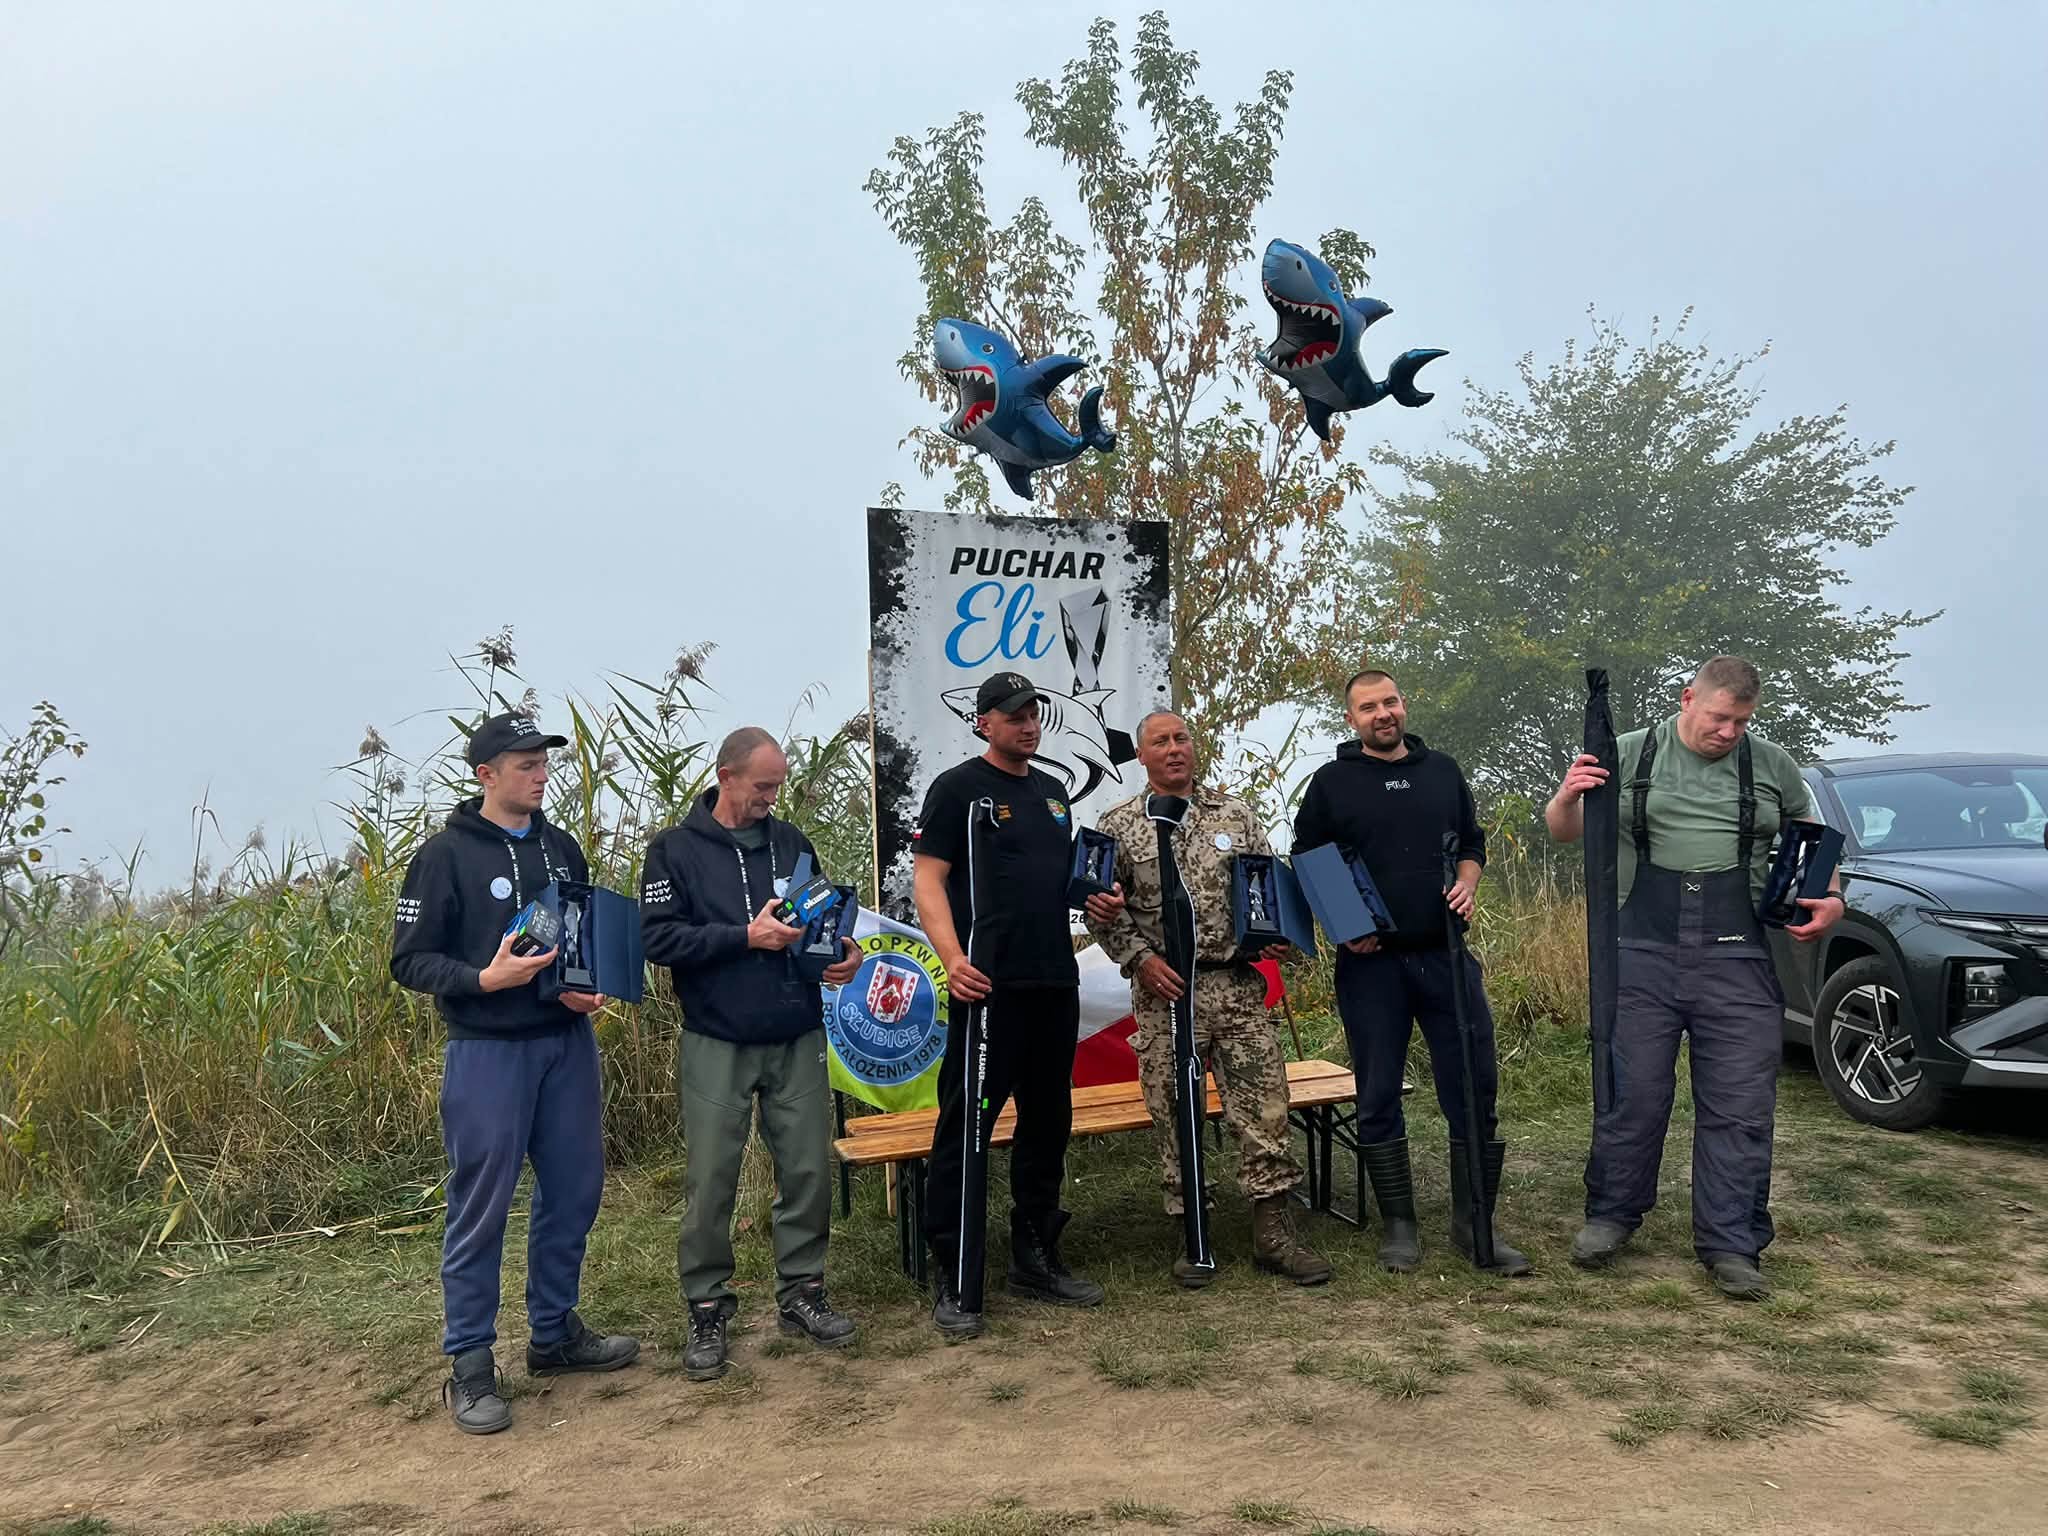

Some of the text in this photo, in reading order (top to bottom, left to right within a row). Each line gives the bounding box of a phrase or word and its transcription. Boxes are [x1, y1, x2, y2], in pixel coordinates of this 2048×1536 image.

[950, 547, 1105, 579] PUCHAR
[945, 581, 1056, 668] Eli
[1385, 780, 1410, 790] FILA
[645, 880, 670, 890] RYBY
[645, 886, 671, 897] RYBY
[645, 894, 672, 904] RYBY
[890, 936, 933, 964] PZW
[840, 1002, 922, 1049] SŁUBICE
[823, 1002, 941, 1079] ROK ZAŁOŻENIA 1978
